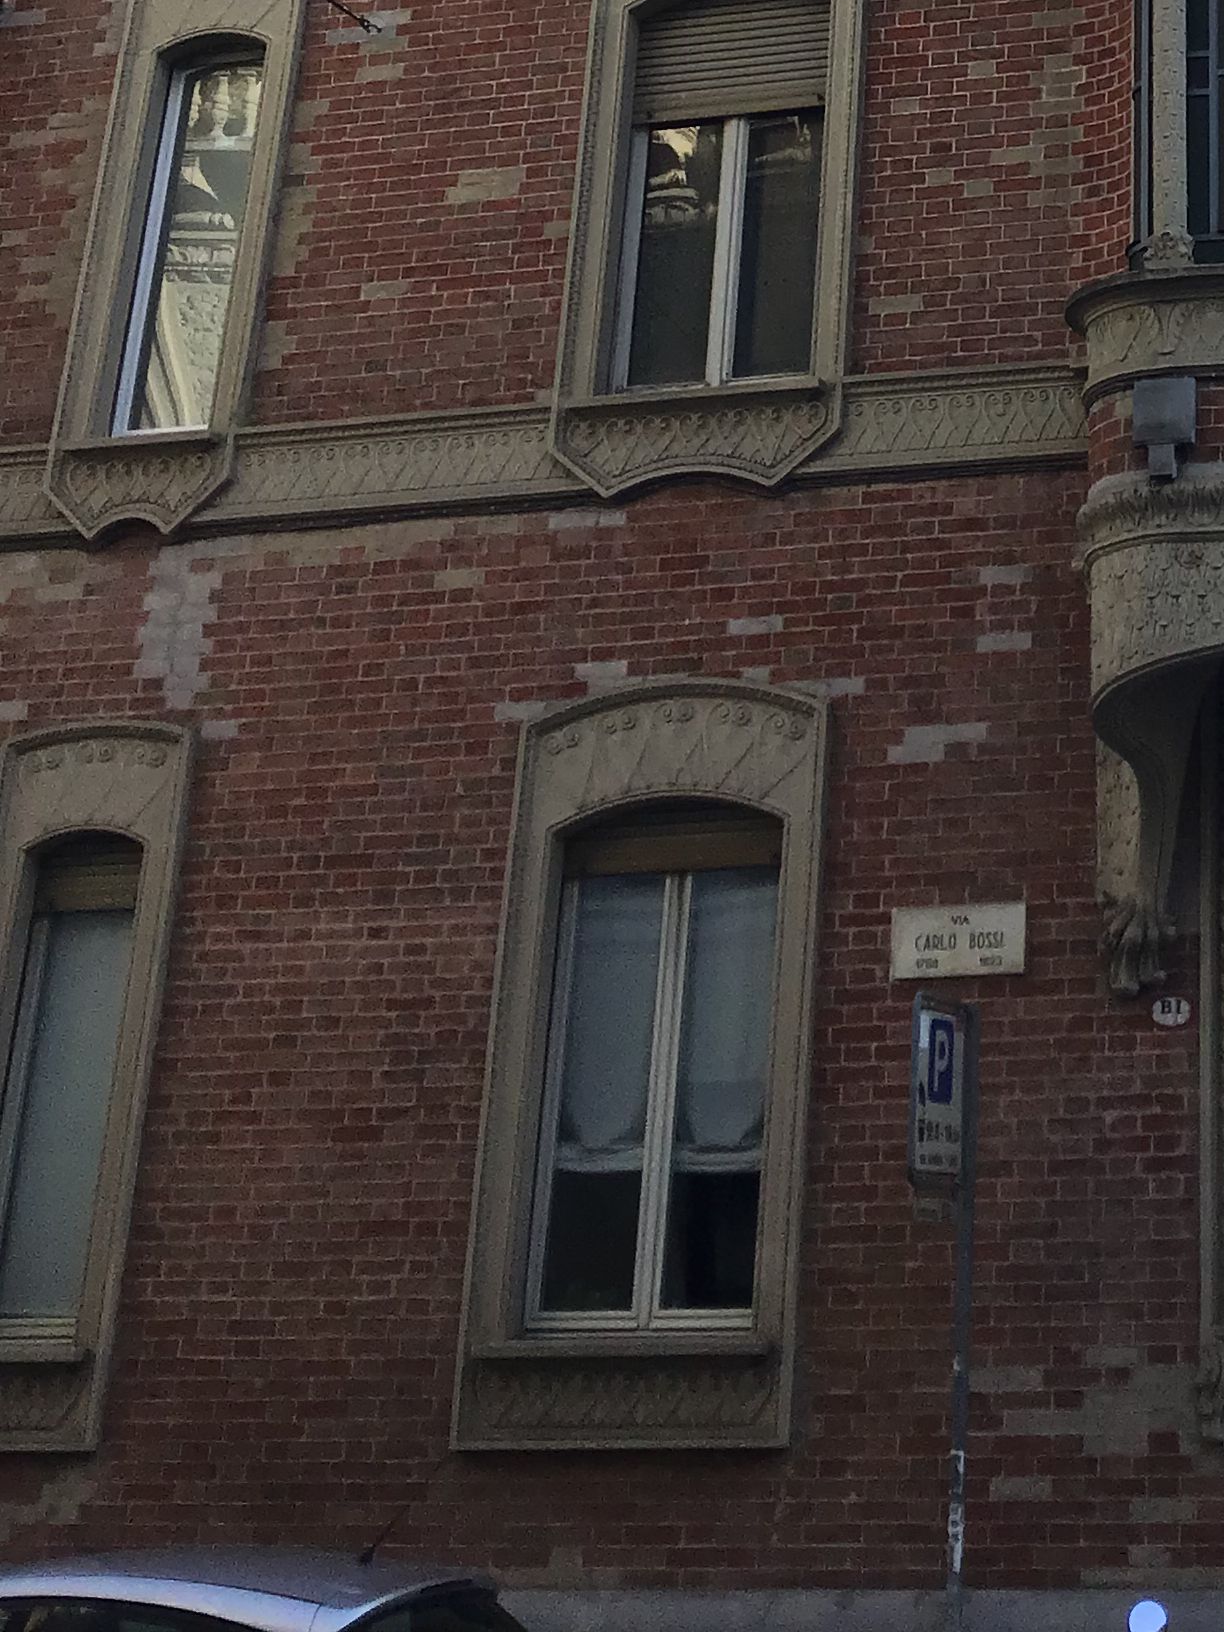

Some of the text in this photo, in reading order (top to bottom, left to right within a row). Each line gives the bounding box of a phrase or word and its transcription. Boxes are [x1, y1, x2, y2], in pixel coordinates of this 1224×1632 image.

[951, 915, 970, 926] VIA
[915, 931, 1005, 951] CARLO BOSSI
[933, 1029, 949, 1092] P
